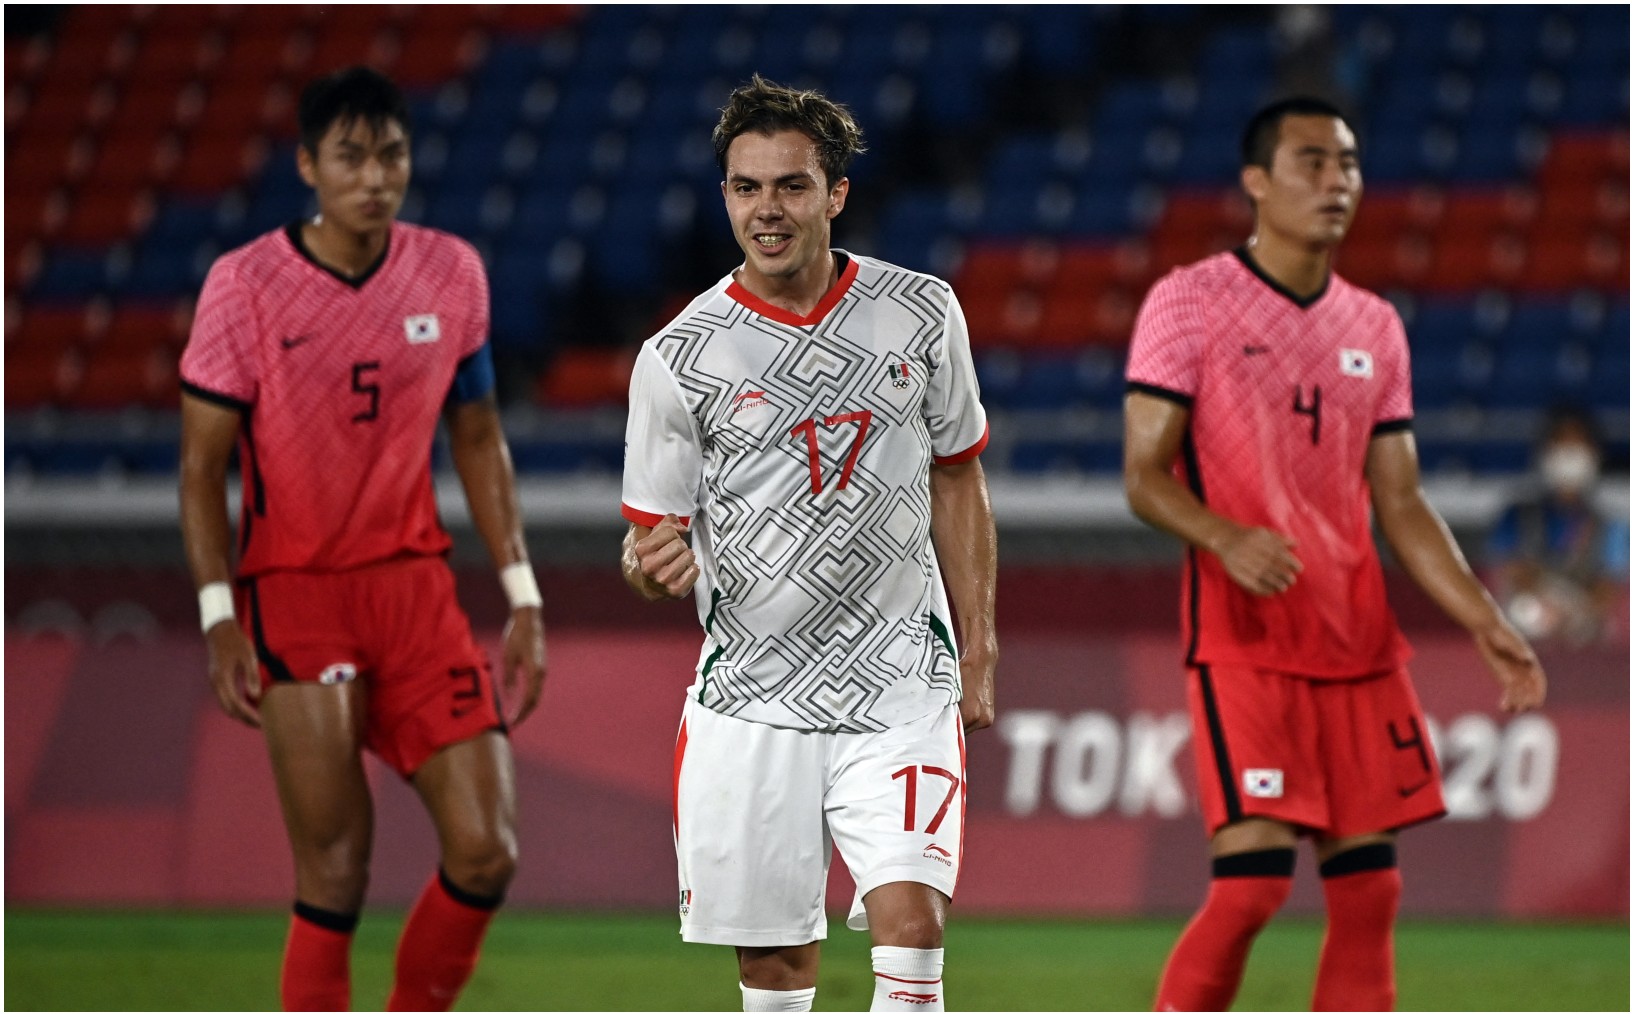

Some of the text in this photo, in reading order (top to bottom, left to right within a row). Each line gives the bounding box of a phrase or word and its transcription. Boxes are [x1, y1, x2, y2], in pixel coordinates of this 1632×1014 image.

[351, 361, 380, 424] 5
[1293, 384, 1321, 445] 4
[790, 410, 873, 494] 17
[1000, 711, 1557, 821] TOK 20
[1386, 714, 1432, 774] 4
[891, 765, 959, 835] 17
